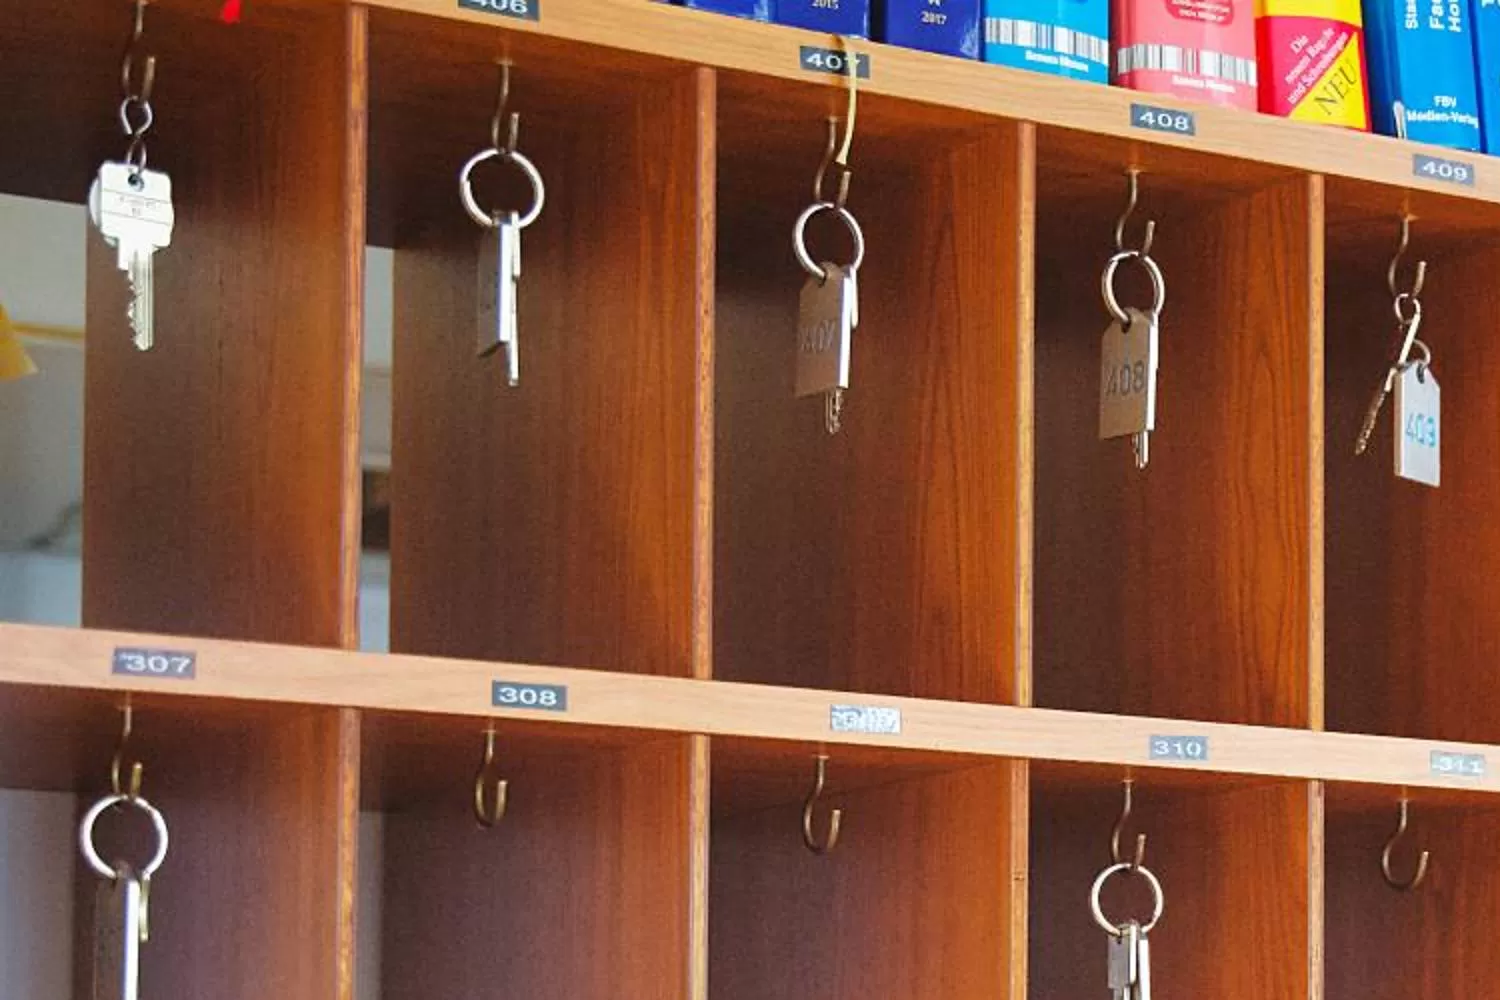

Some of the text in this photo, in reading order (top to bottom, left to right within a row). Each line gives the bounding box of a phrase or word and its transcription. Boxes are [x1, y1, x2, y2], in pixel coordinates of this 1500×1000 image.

[1314, 58, 1358, 116] NEU
[1139, 110, 1189, 131] 408
[1423, 161, 1468, 181] 409
[1104, 359, 1145, 396] 408
[121, 653, 192, 673] 307
[499, 687, 558, 706] 308
[1154, 740, 1202, 756] 310
